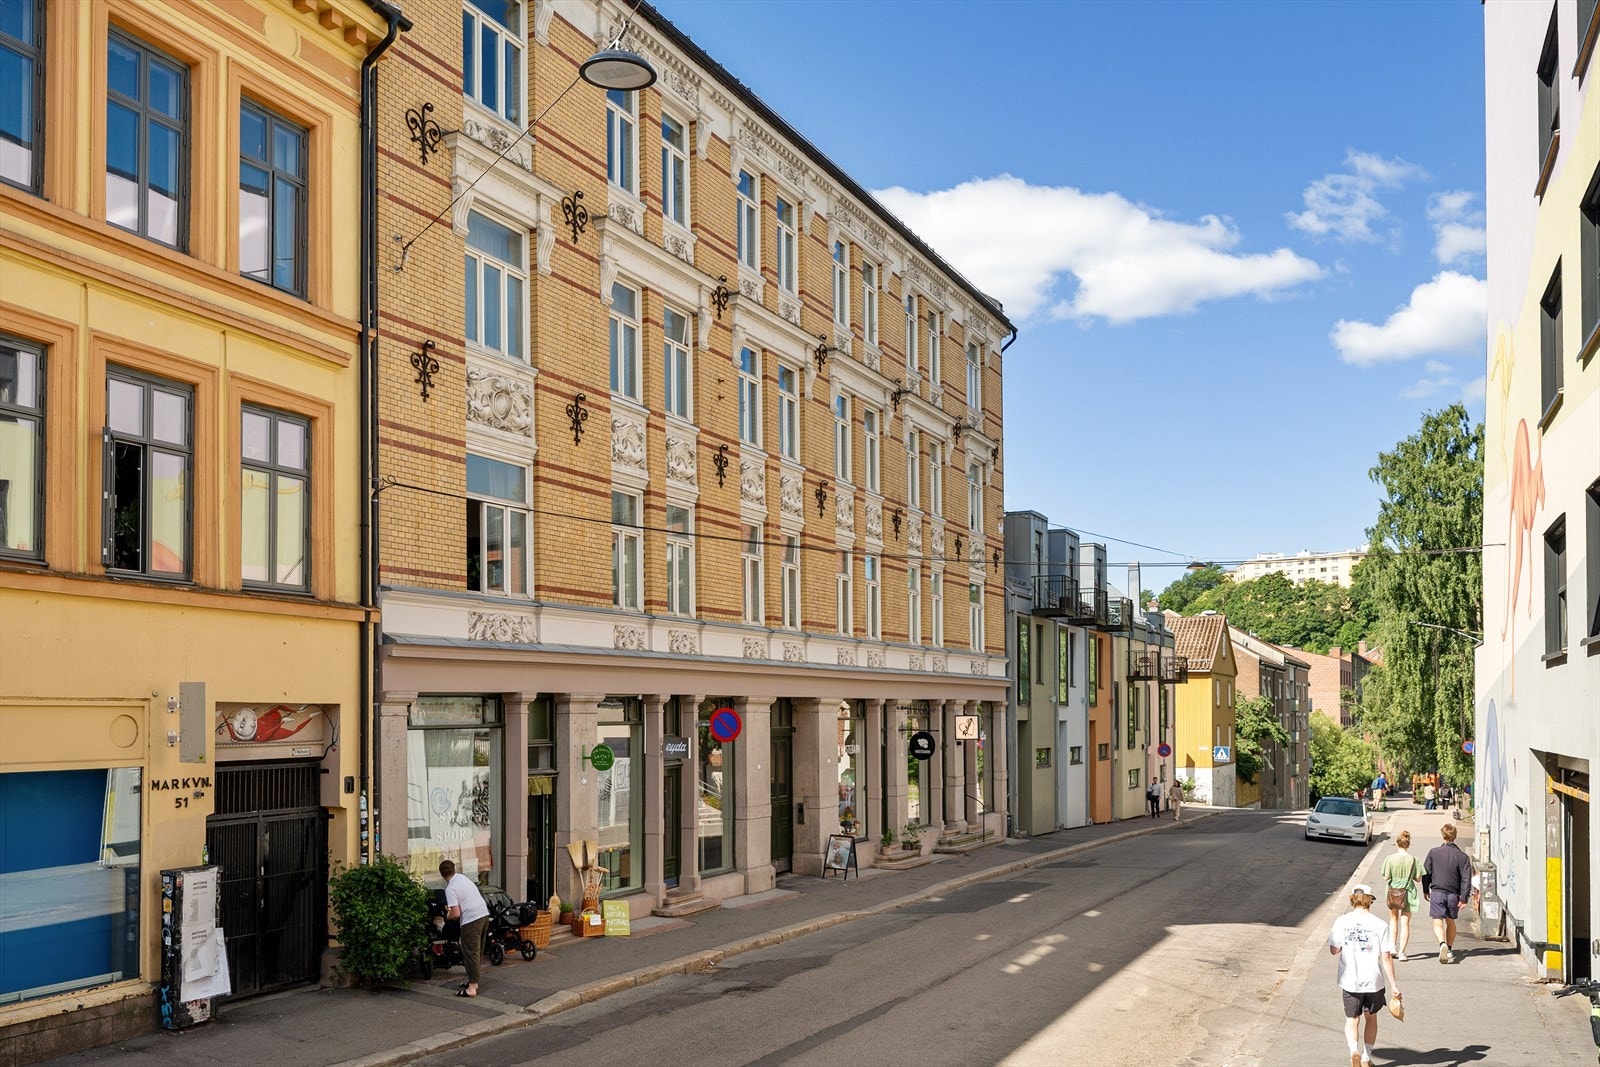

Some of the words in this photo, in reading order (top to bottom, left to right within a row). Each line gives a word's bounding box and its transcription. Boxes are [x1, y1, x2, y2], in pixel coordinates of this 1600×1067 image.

[665, 741, 687, 754] eyda
[151, 776, 212, 791] MARKVN.
[175, 797, 188, 808] 51
